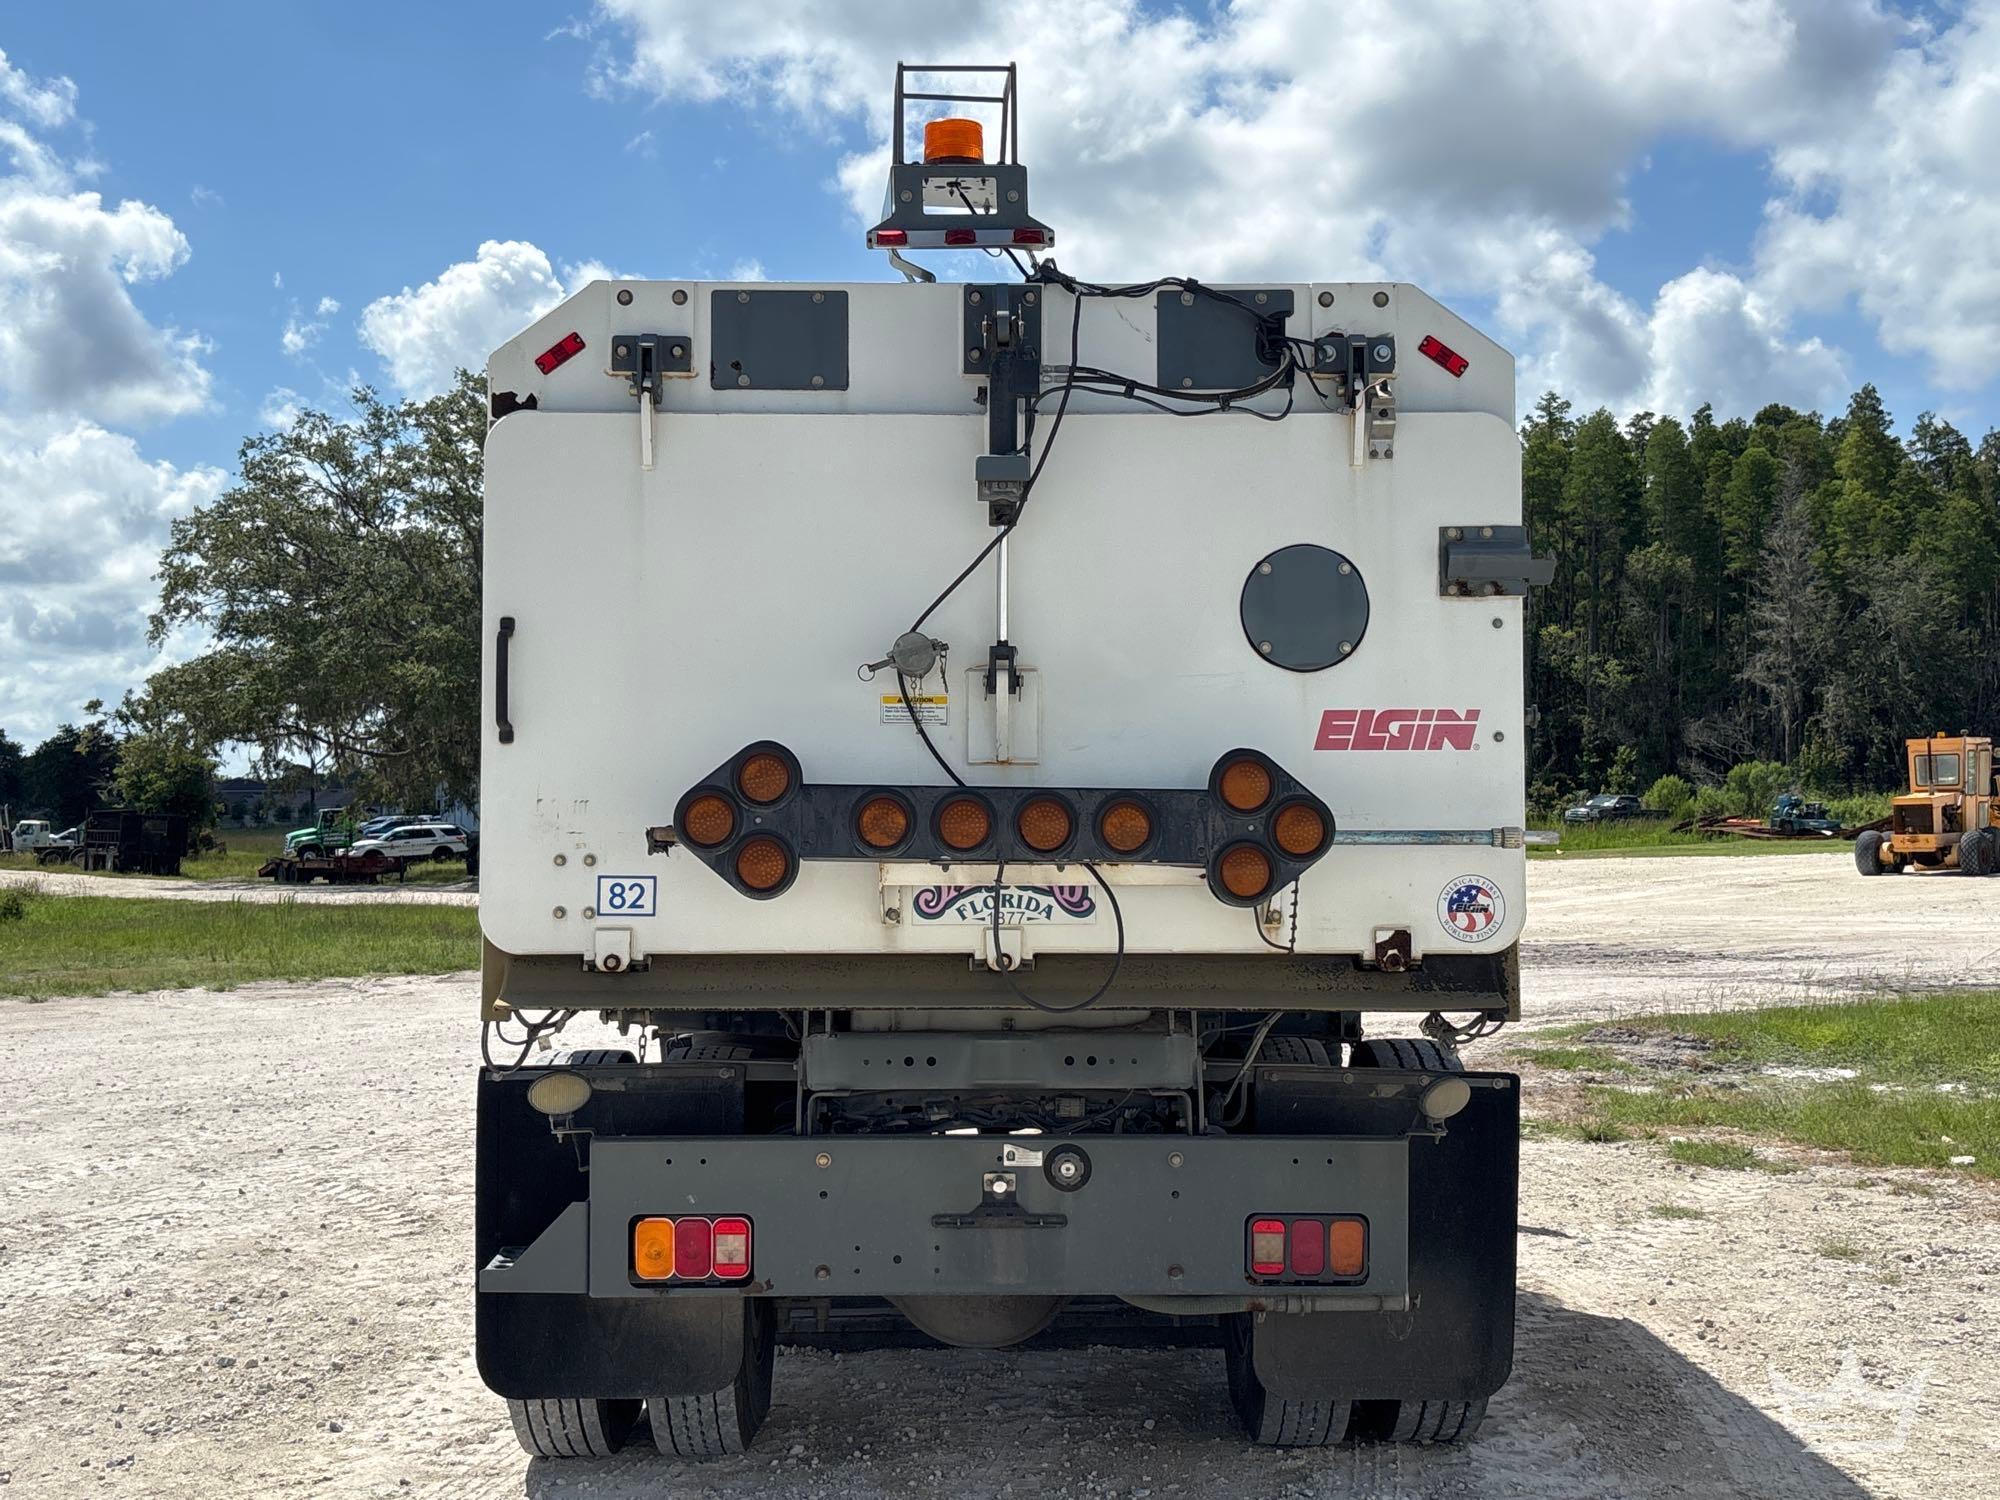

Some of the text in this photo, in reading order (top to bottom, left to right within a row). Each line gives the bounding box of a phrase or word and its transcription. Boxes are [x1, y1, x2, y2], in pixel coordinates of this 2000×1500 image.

[1313, 709, 1481, 751] ELGIN
[608, 882, 646, 910] 82
[1442, 877, 1500, 902] AMERICA'S FIRST
[955, 893, 1054, 921] FLORIDA
[1454, 903, 1491, 913] ELGIN
[1443, 918, 1500, 940] WORLD'S FINEST
